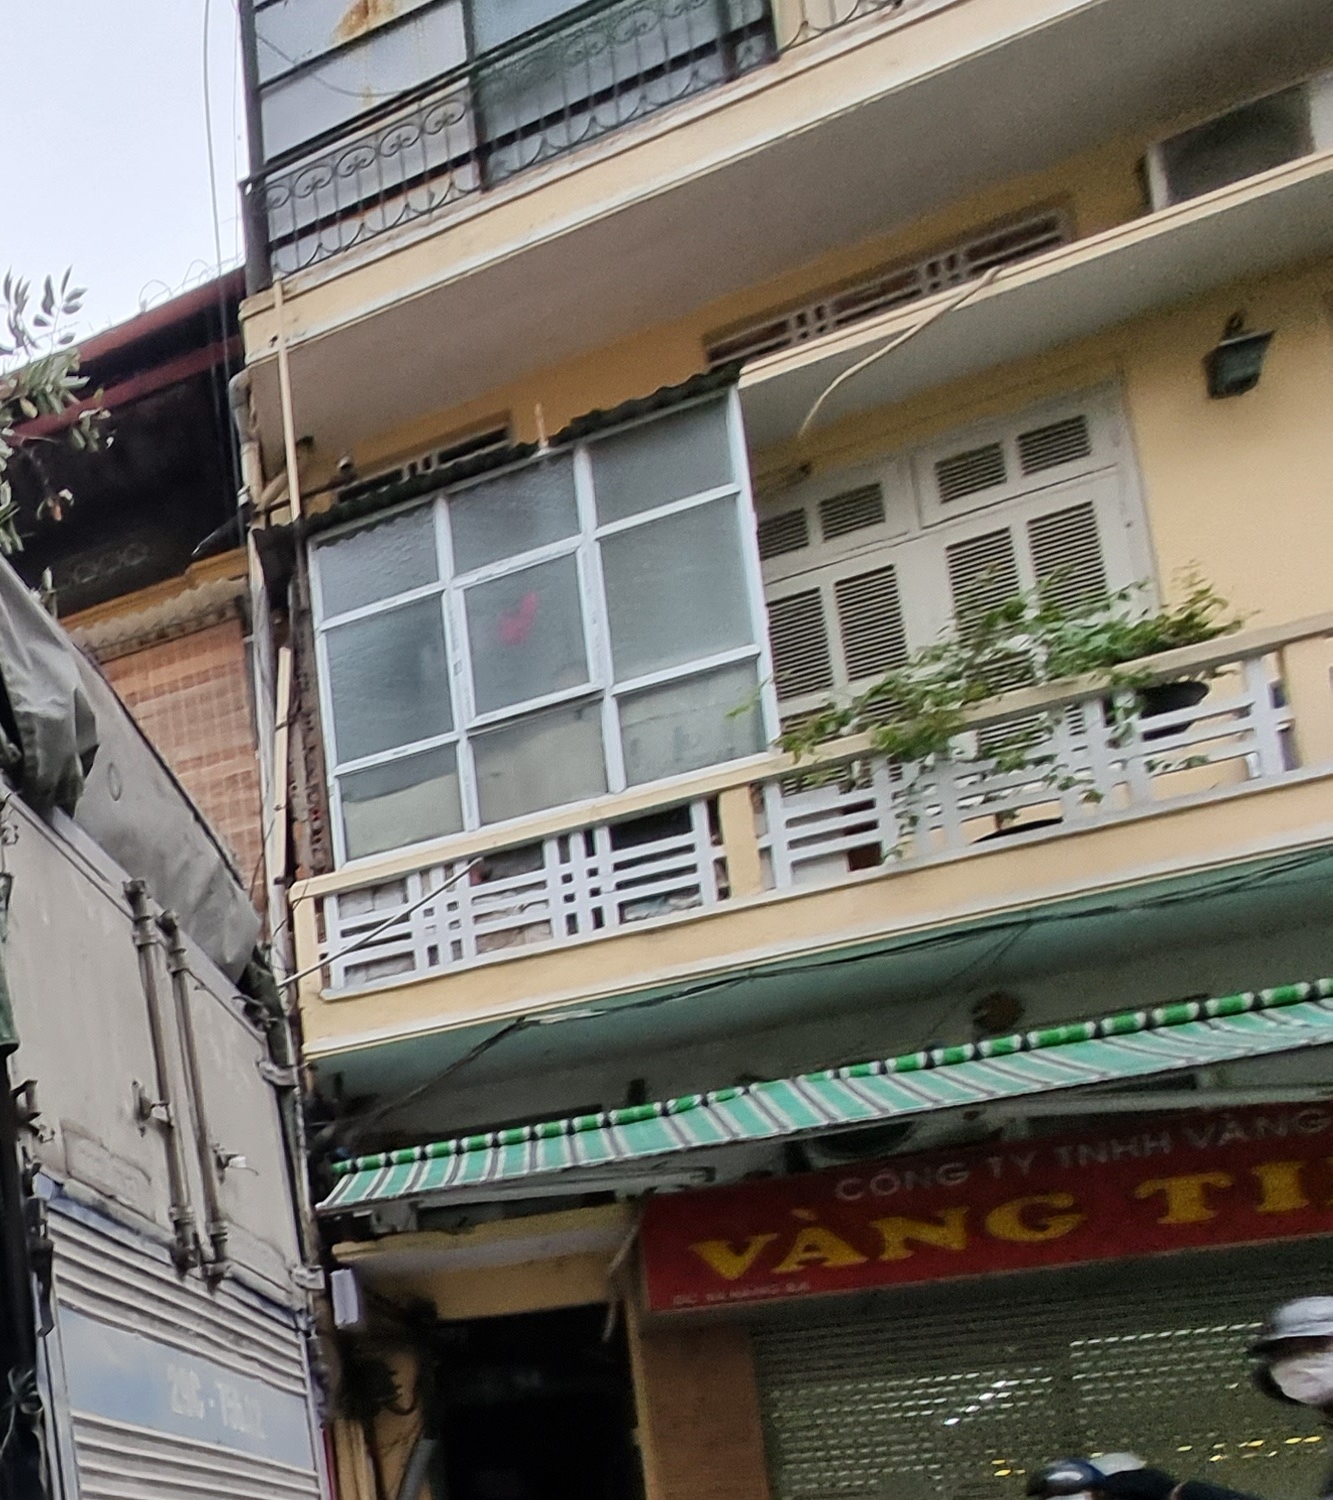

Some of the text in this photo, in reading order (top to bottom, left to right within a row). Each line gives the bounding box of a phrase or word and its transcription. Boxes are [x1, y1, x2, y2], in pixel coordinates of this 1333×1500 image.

[985, 1152, 1036, 1179] TY
[1054, 1131, 1172, 1168] TNHH
[1182, 1108, 1332, 1149] VÀNG
[688, 1156, 1333, 1281] VÀNG TI
